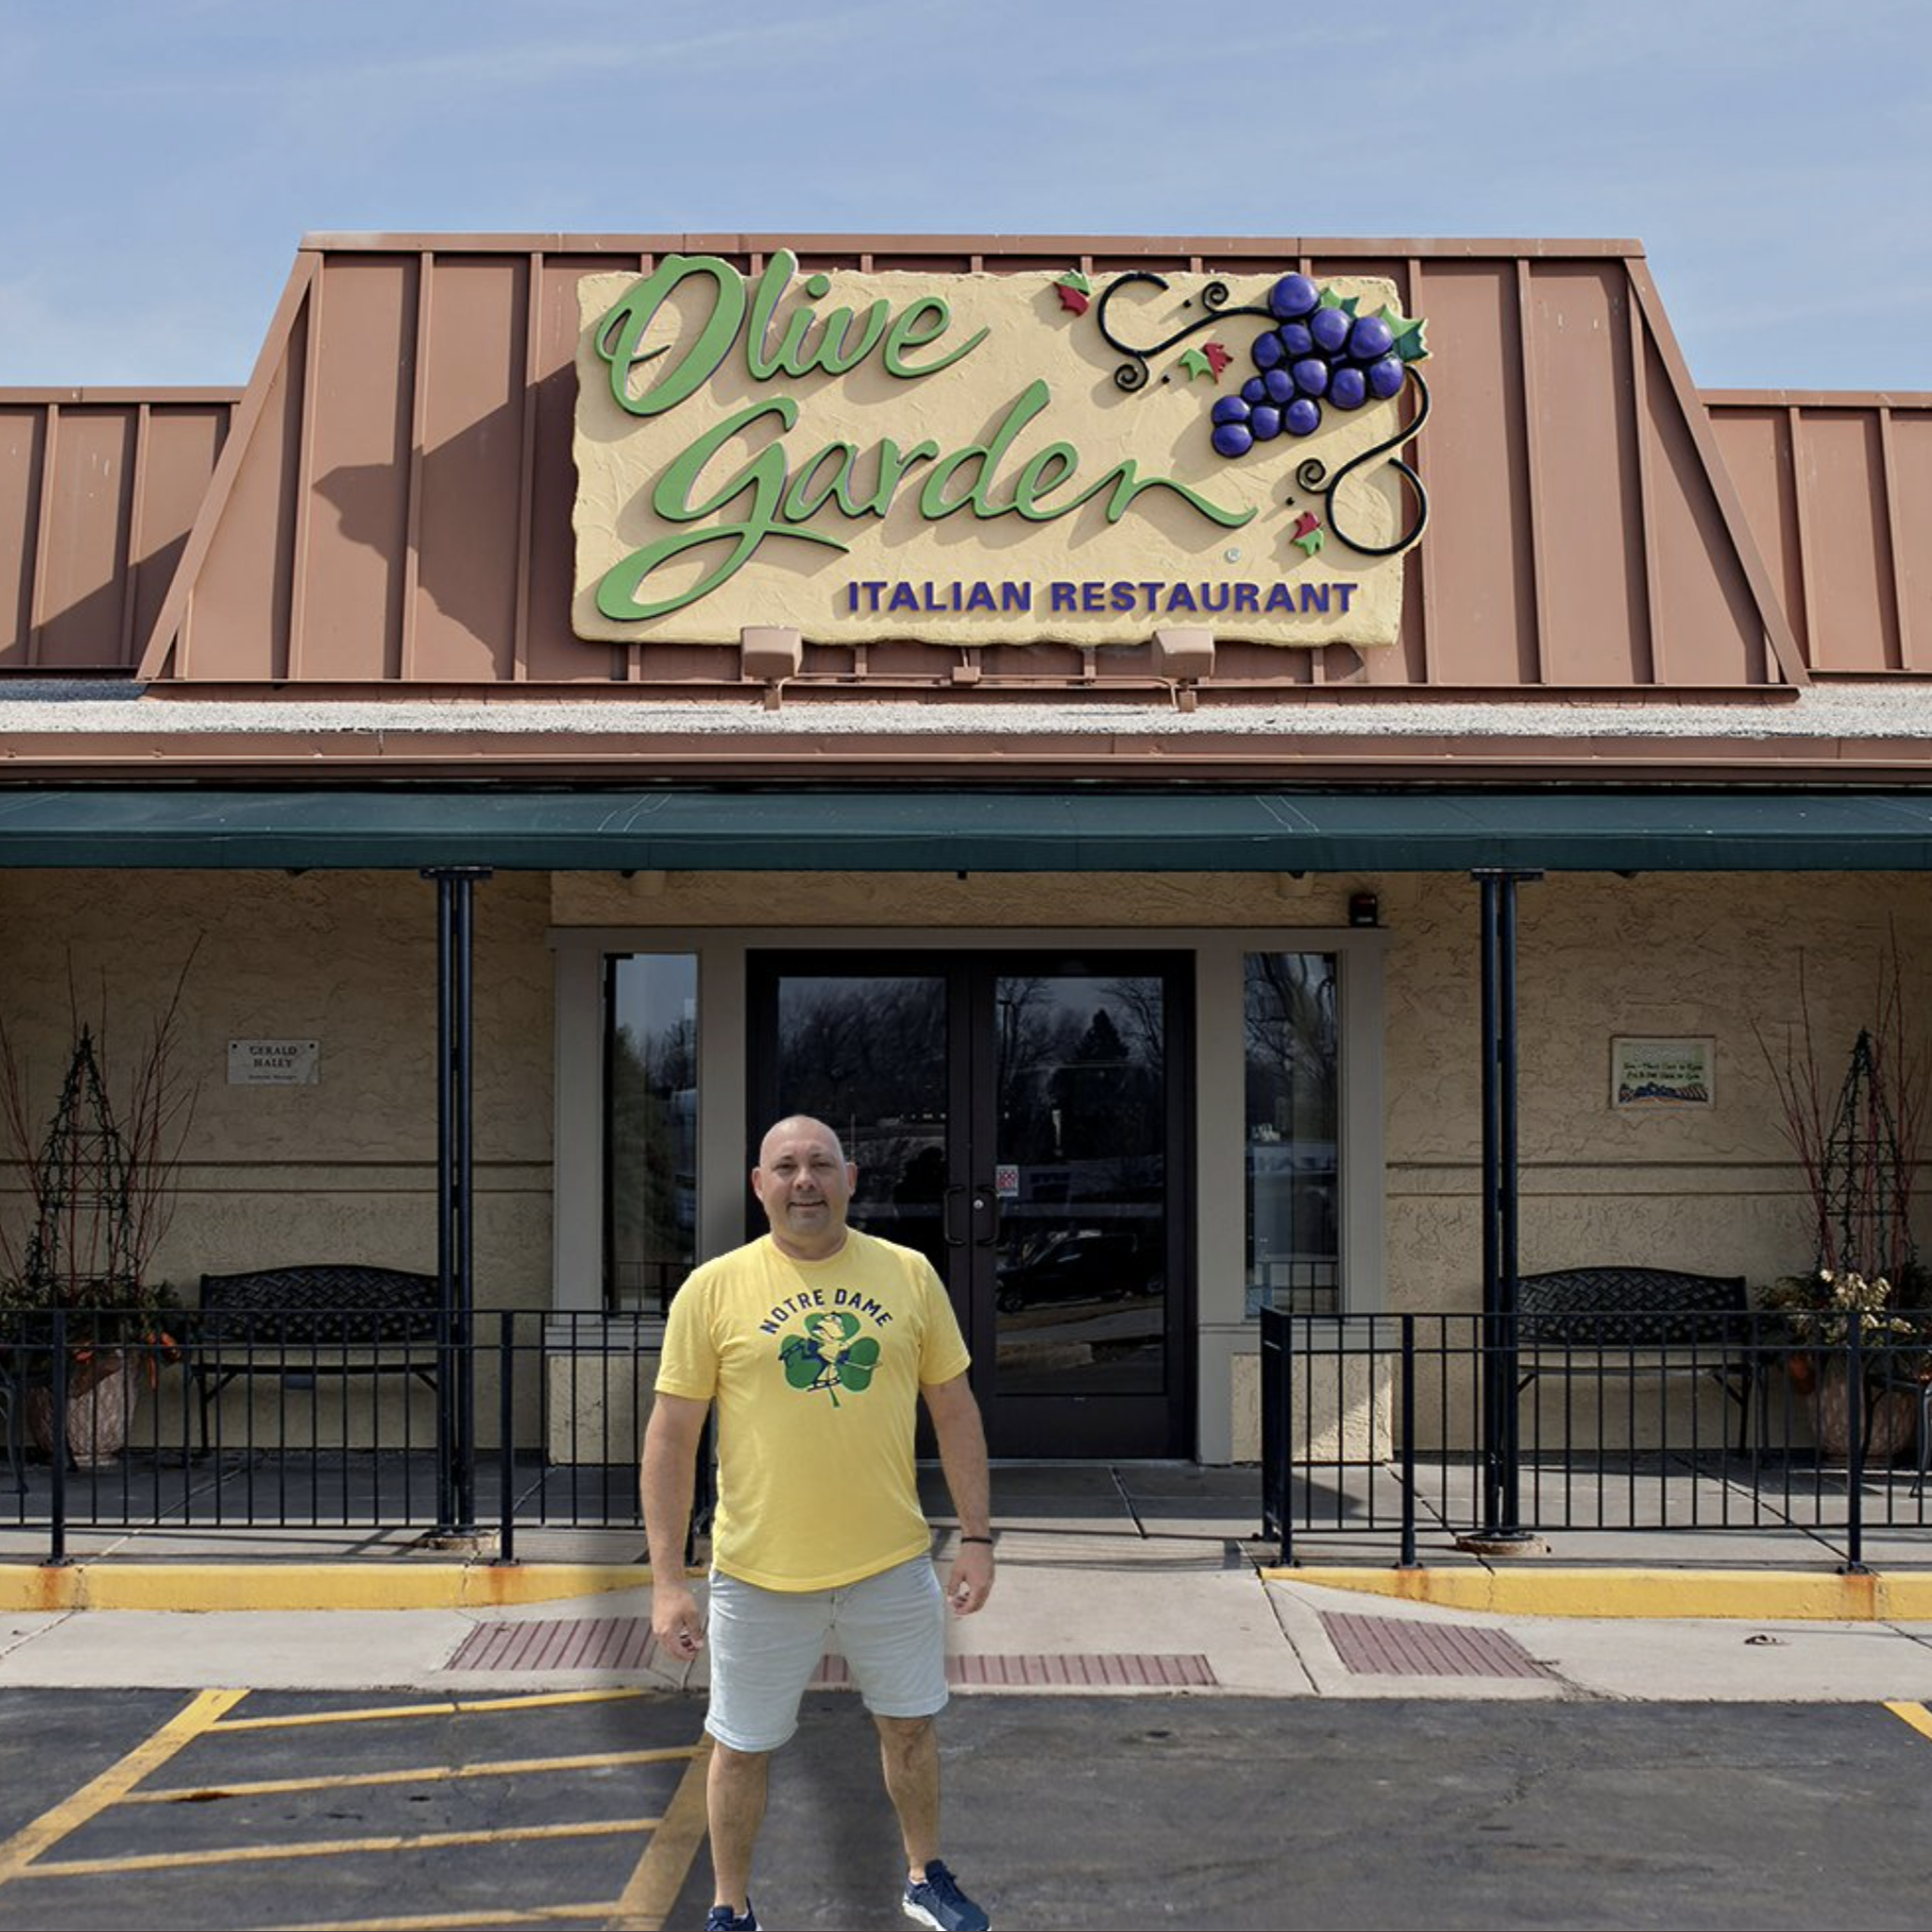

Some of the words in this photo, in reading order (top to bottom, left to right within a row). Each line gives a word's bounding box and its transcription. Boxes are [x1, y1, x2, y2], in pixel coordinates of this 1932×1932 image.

[594, 247, 990, 417] Olive
[595, 378, 1259, 620] Garden
[847, 580, 1032, 612] ITALIAN
[1050, 581, 1359, 613] RESTAURANT
[759, 1288, 825, 1335] NOTRE
[834, 1288, 893, 1327] DAME
